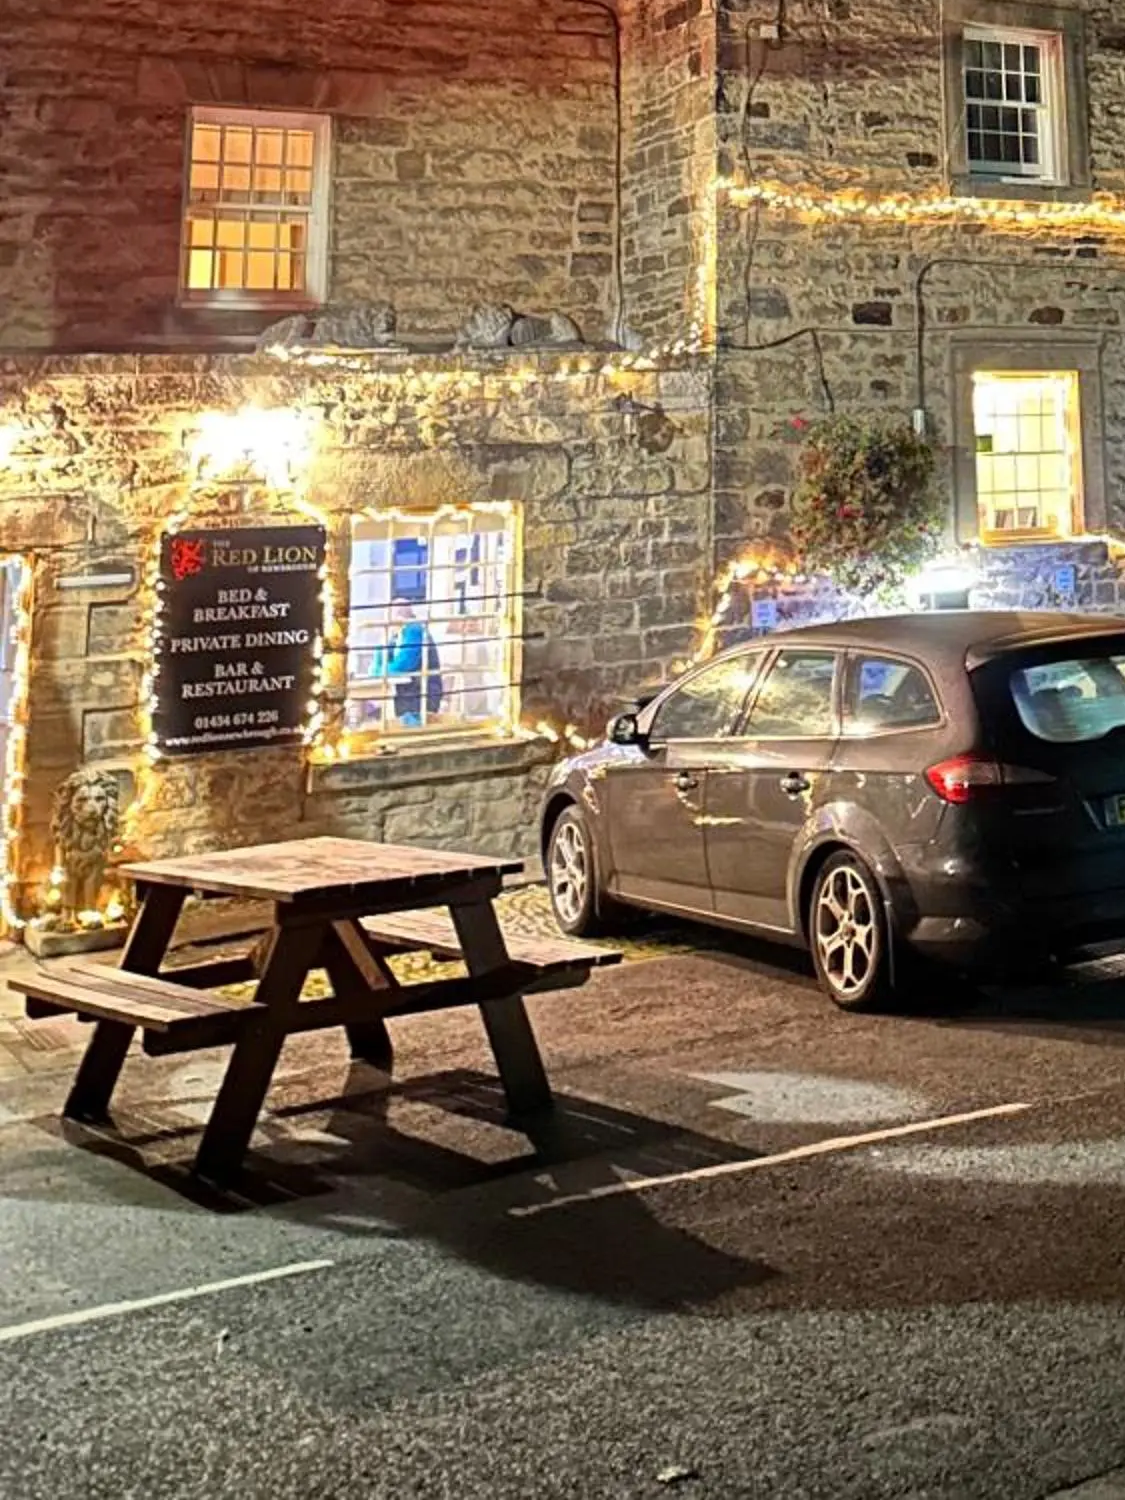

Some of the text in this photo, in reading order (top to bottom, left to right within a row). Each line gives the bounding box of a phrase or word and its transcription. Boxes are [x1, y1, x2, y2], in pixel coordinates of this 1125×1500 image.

[211, 546, 317, 567] RED LION
[217, 588, 268, 604] BED &
[193, 603, 291, 623] BREAKFAST
[171, 630, 309, 653] PRIVATE DINING
[214, 661, 265, 678] BAR &
[181, 676, 295, 699] RESTAURANT
[194, 715, 231, 730] 01434
